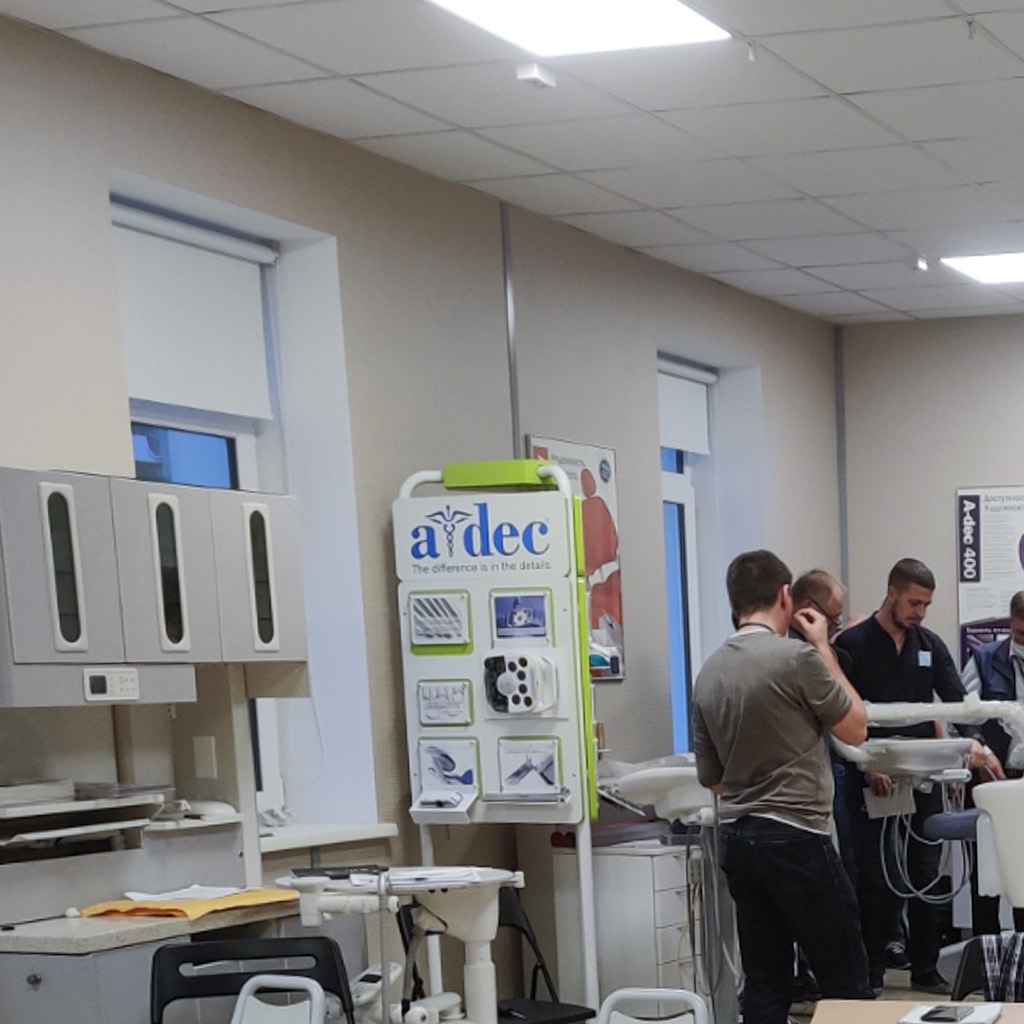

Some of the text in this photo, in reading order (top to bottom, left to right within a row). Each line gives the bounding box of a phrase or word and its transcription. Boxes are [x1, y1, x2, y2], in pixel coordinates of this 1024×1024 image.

[962, 499, 977, 579] A-dec 400
[412, 564, 430, 574] The
[431, 564, 478, 574] difference
[501, 561, 518, 571] the
